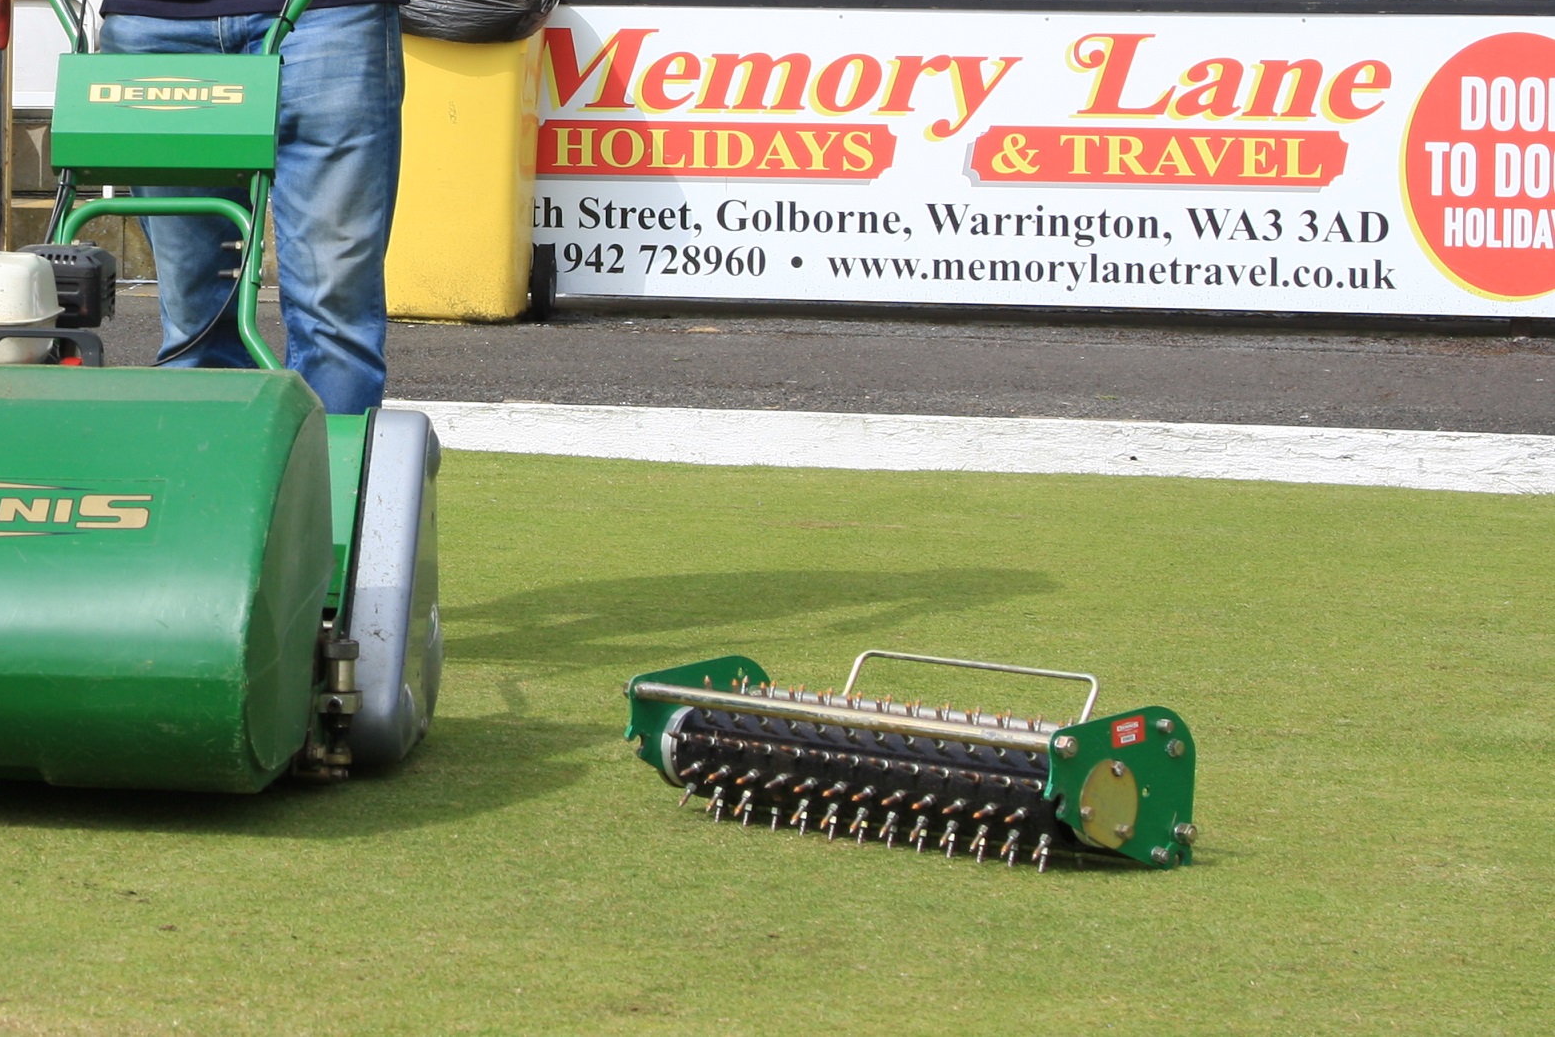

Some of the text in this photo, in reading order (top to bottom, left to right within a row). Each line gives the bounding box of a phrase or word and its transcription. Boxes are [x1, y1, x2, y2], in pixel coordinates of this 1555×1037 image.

[89, 83, 244, 104] DENNIS
[542, 27, 1392, 142] Memory Lane
[1460, 76, 1555, 132] DOO
[551, 127, 1323, 179] HOLIDAYS & TRAVEL
[1425, 141, 1477, 197] TO
[577, 195, 702, 233] Street,
[715, 198, 912, 240] Golborne,
[924, 201, 1173, 248] Warrington,
[1186, 207, 1284, 243] WA3
[1297, 210, 1389, 245] 3AD
[1444, 206, 1555, 250] HOLIDA
[640, 241, 766, 277] 728960
[826, 252, 1397, 292] www.memorylanetravel.co.uk
